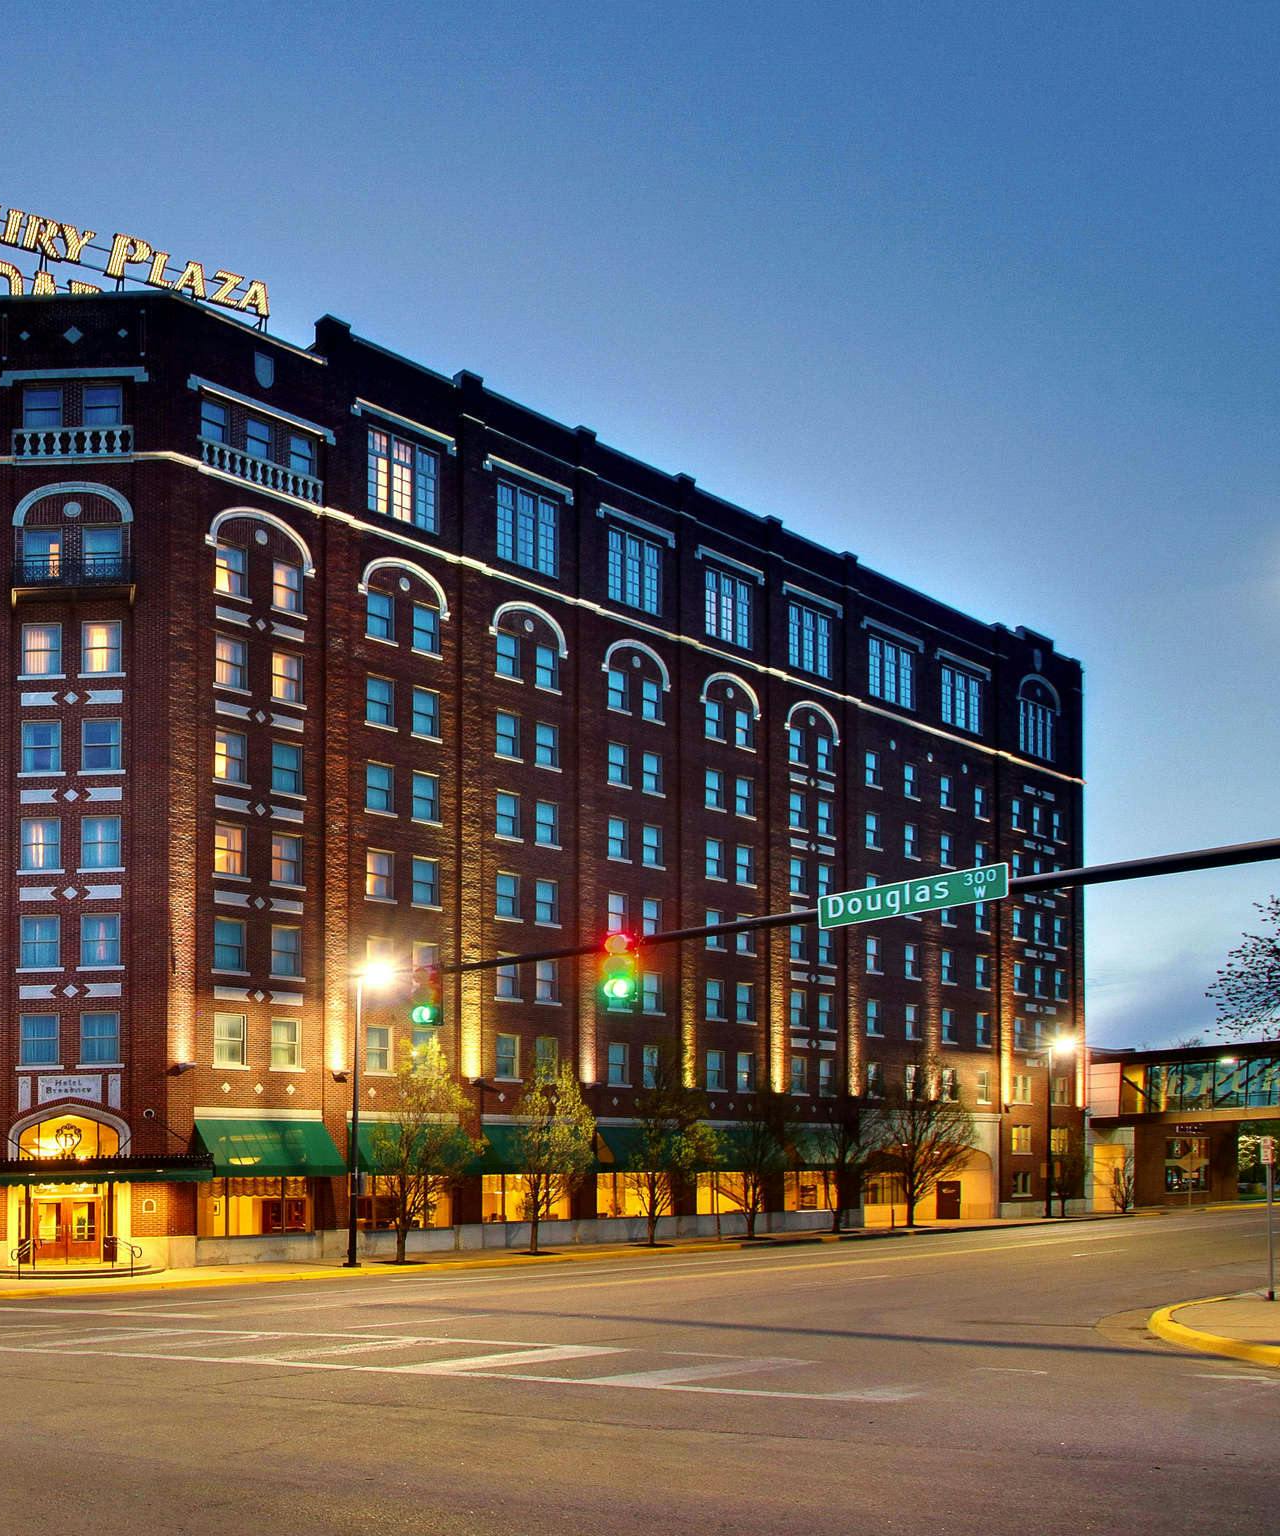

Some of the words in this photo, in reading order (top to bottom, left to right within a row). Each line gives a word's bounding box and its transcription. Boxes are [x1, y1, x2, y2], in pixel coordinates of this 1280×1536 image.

[104, 232, 271, 317] PLAZA
[964, 869, 997, 886] 300
[828, 881, 950, 919] Douglas
[974, 885, 987, 899] W
